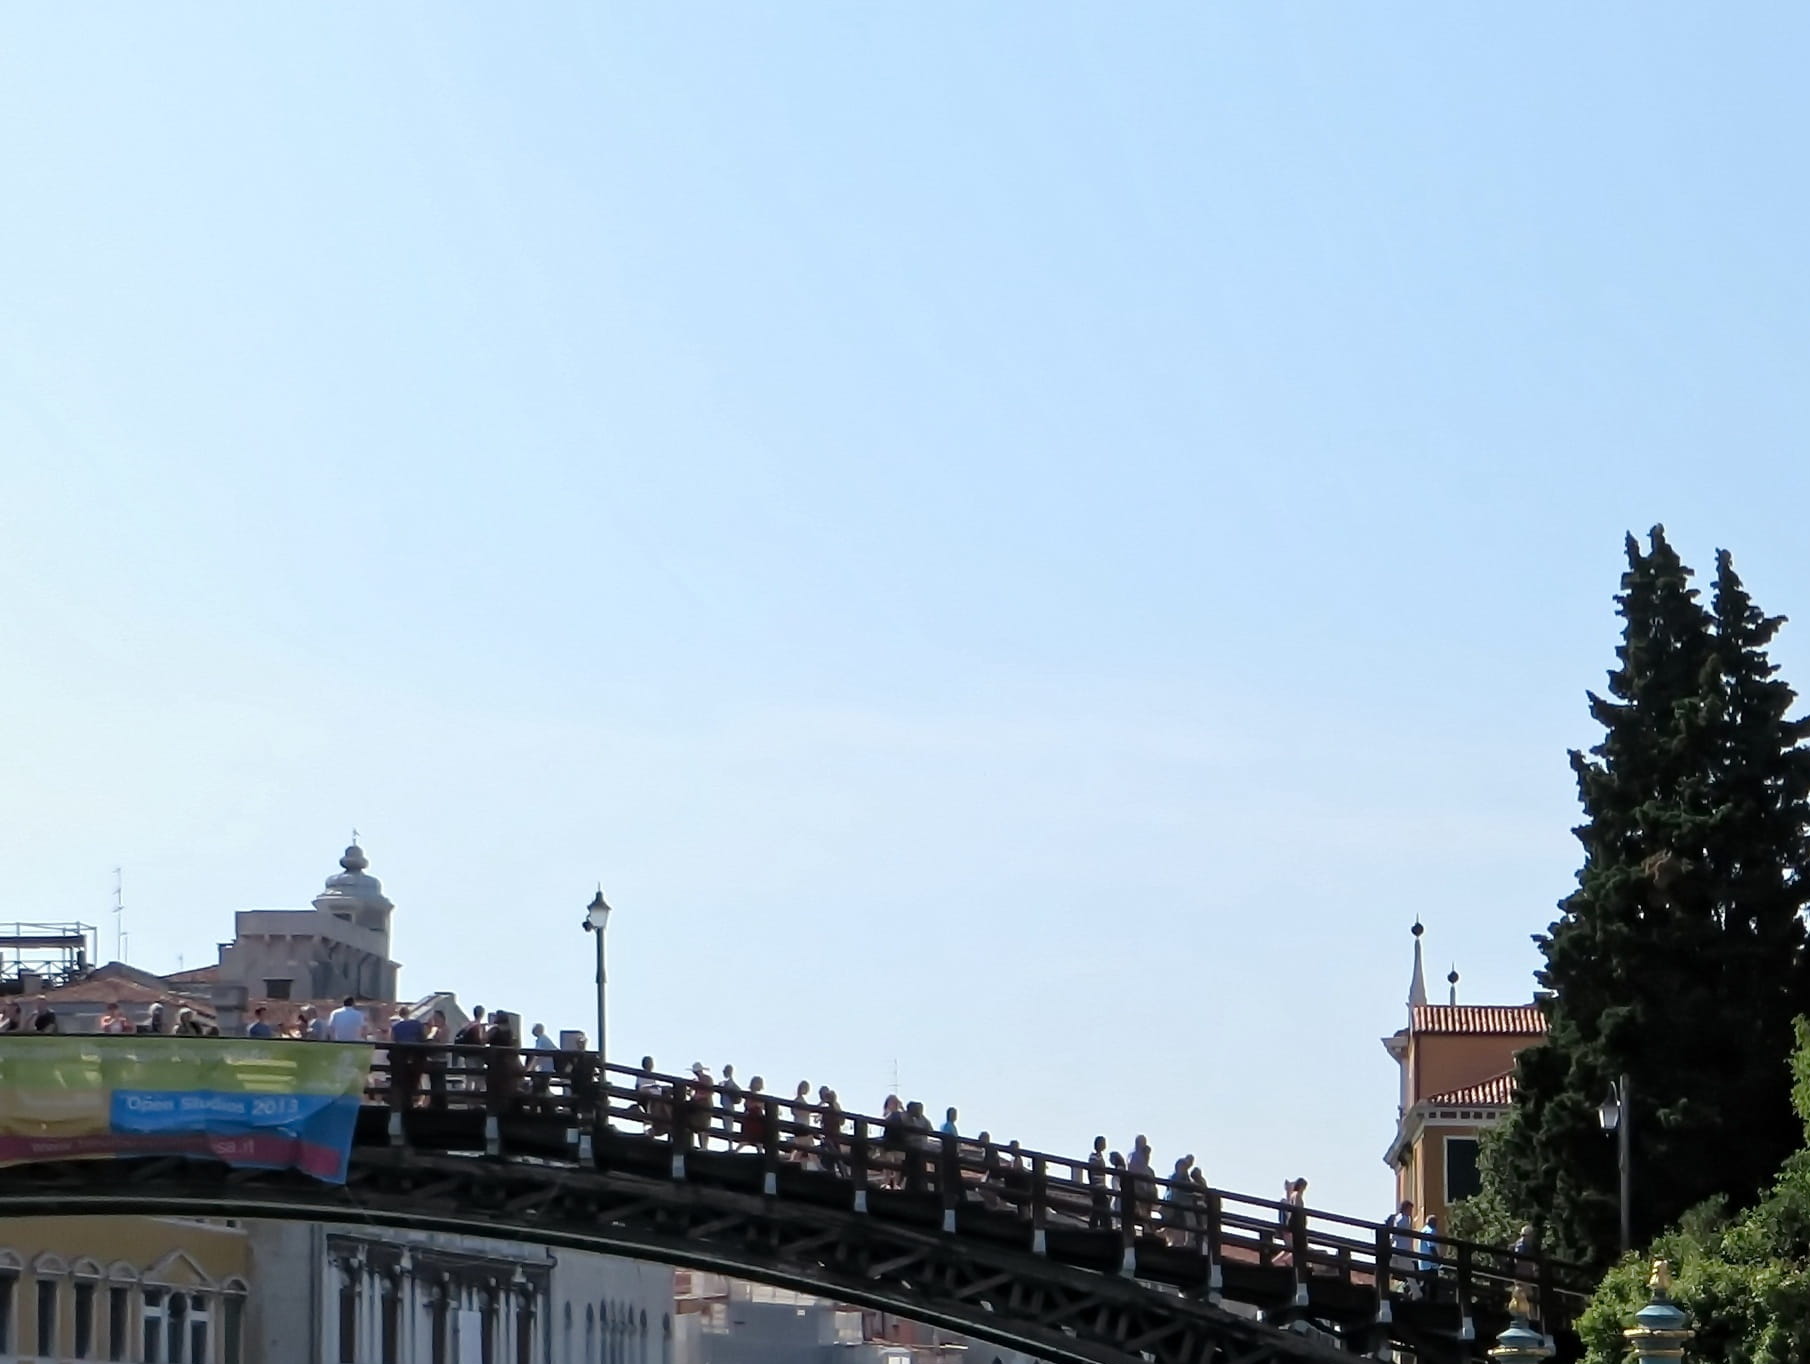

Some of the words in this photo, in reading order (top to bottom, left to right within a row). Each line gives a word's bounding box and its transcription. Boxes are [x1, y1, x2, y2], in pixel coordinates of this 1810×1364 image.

[126, 1095, 175, 1113] Open
[181, 1096, 245, 1115] Studios
[251, 1097, 299, 1115] 2013
